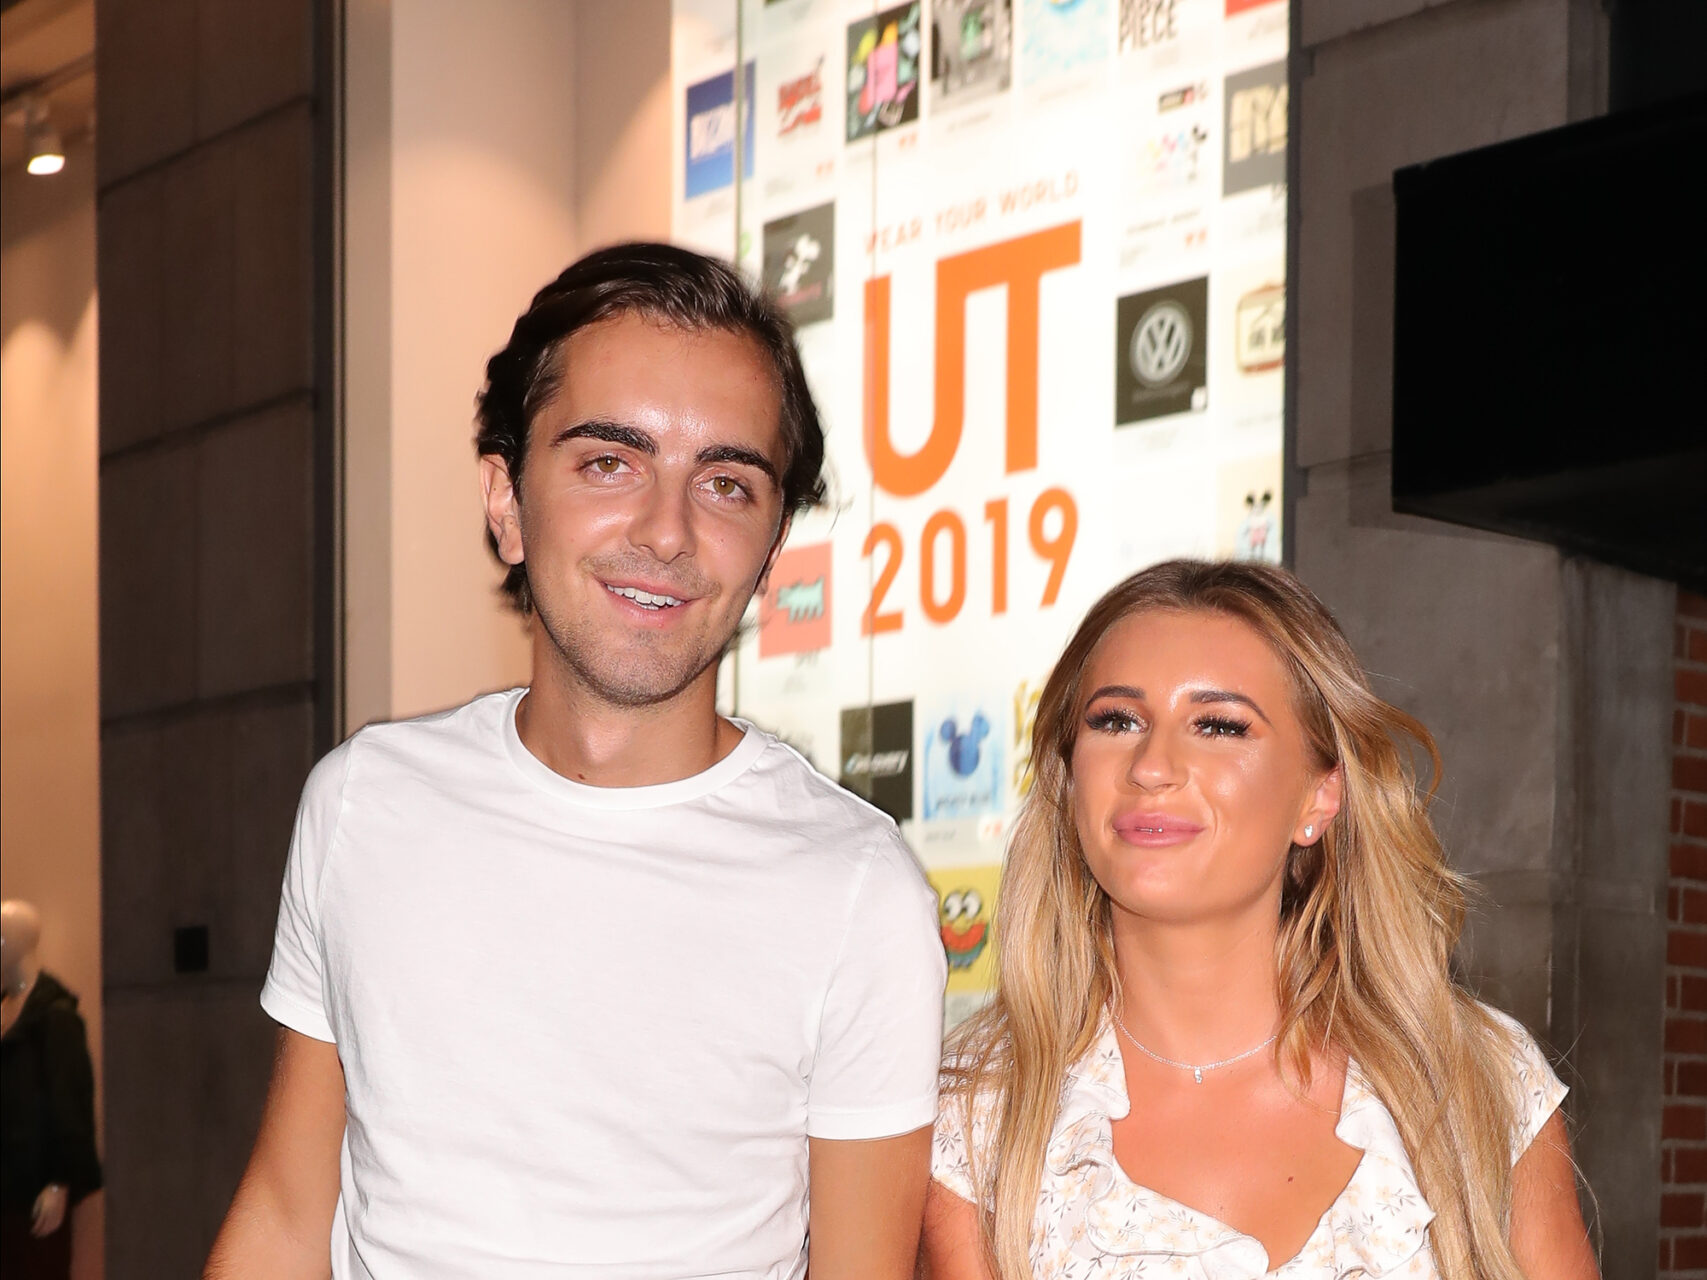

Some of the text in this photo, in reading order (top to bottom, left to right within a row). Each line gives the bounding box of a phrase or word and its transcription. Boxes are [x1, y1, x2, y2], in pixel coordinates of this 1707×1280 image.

[935, 196, 987, 234] YOUR
[998, 168, 1078, 215] WORLD
[863, 217, 1082, 498] UT
[861, 486, 1078, 638] 2019
